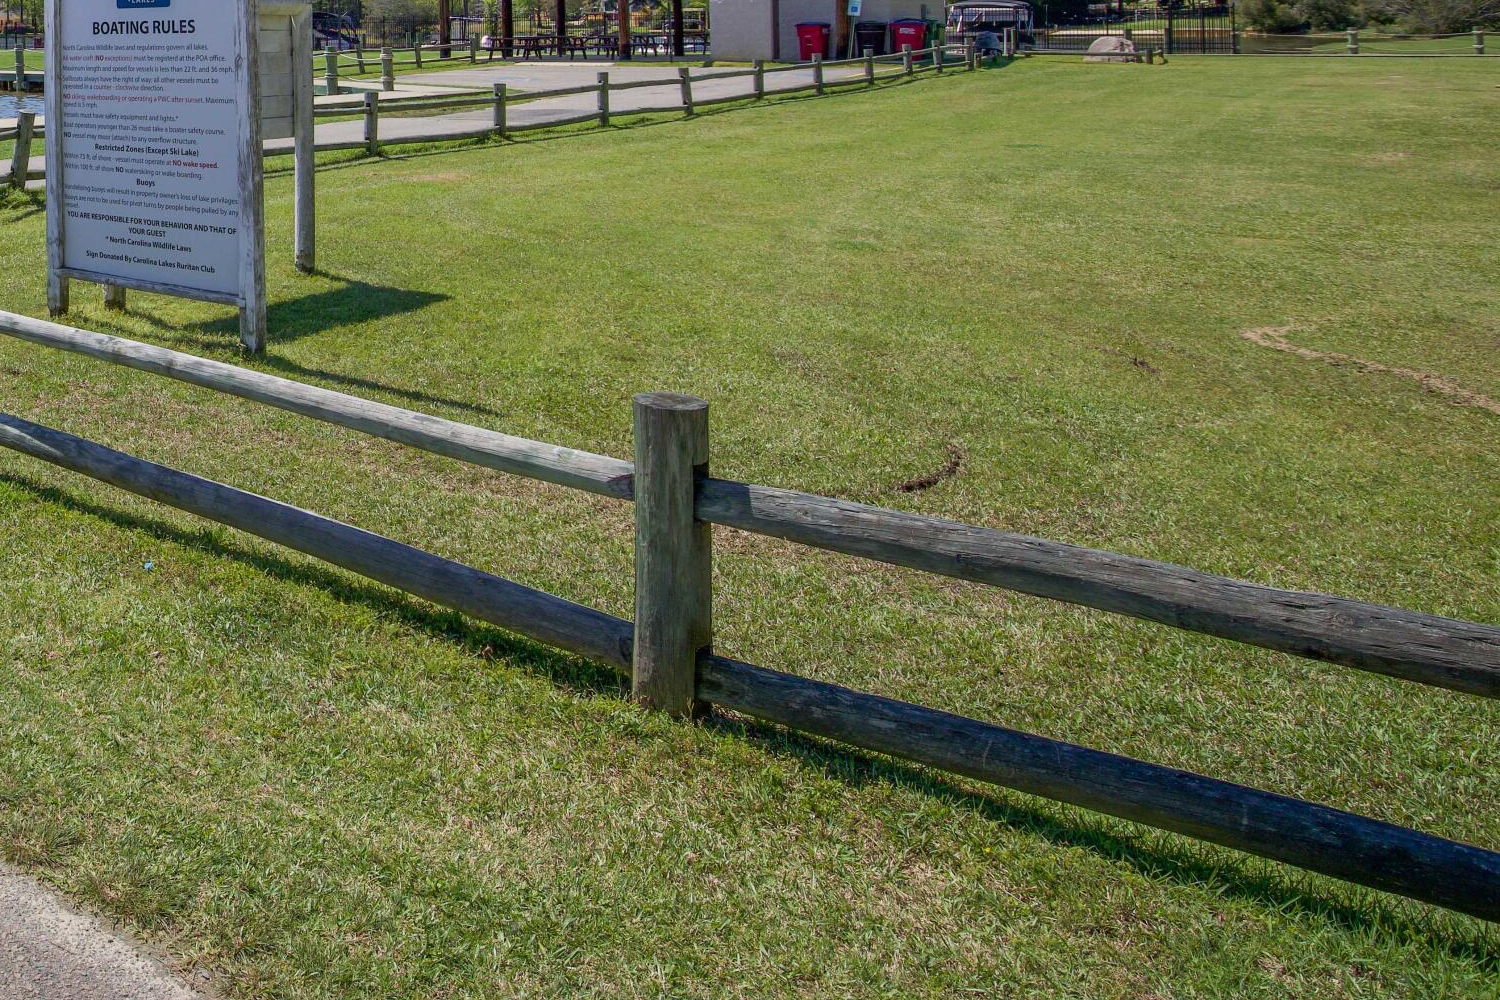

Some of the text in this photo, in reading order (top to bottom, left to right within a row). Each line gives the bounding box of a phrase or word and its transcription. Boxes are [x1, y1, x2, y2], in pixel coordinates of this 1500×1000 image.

[93, 20, 195, 34] BOATING RULES
[146, 147, 168, 155] (Except
[181, 149, 199, 157] Lake)
[137, 179, 155, 188] Buoys
[185, 205, 200, 213] being
[92, 214, 129, 223] RESPONSIBLE
[161, 220, 192, 230] BEHAVIOR
[110, 236, 126, 244] North
[128, 238, 151, 247] Carolina
[153, 242, 175, 250] Wildlife
[86, 250, 98, 258] Sign
[100, 252, 123, 260] Donated
[133, 257, 157, 266] Carolina
[158, 260, 175, 268] Lakes
[177, 262, 199, 271] Ruritan
